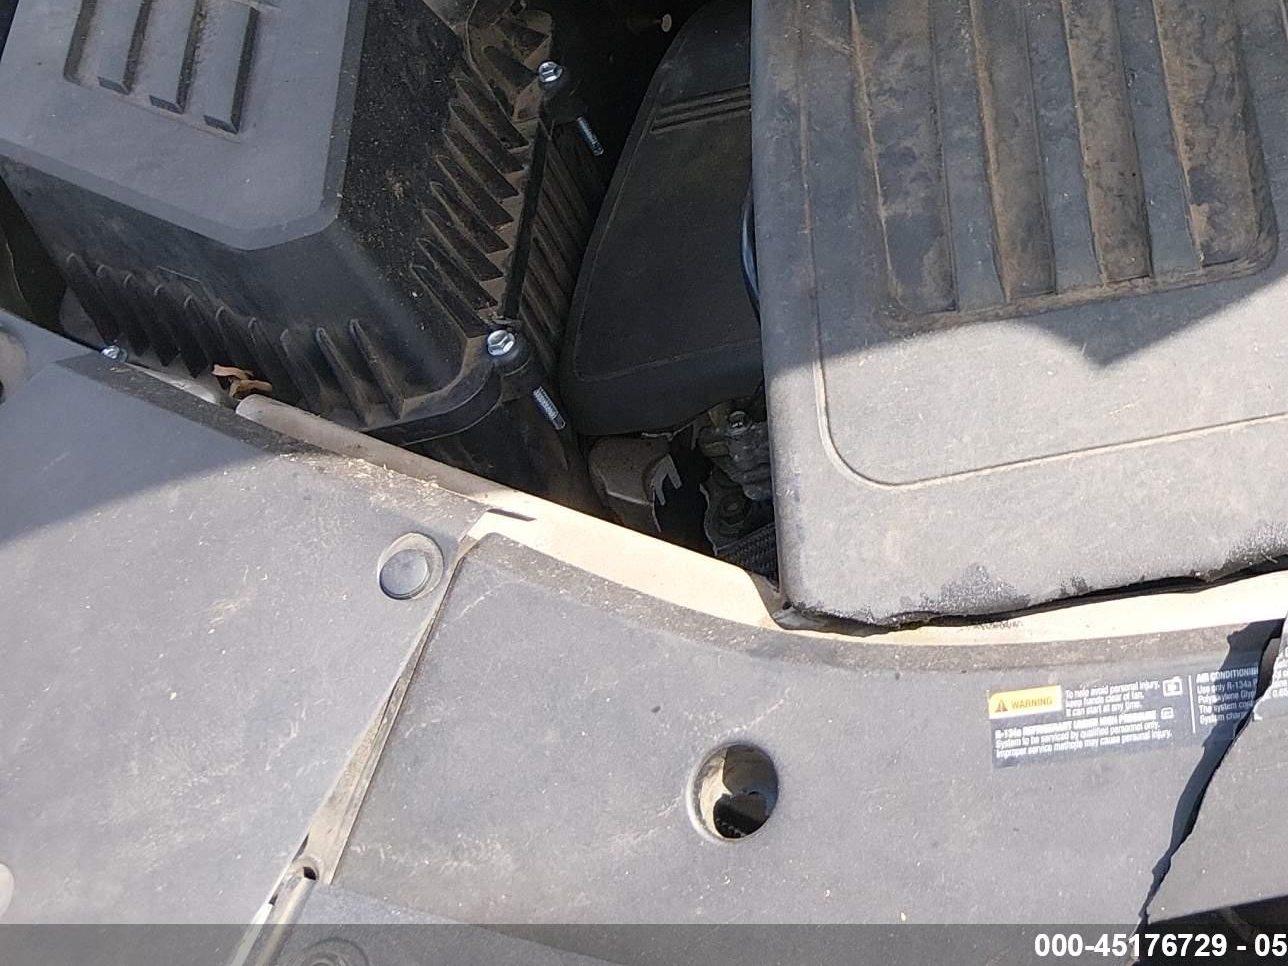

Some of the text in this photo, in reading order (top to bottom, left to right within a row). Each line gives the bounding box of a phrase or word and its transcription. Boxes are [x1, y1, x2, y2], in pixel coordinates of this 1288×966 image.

[1227, 681, 1252, 690] R-134a
[1011, 697, 1053, 709] WARNING
[995, 728, 1022, 739] R-134a
[995, 738, 1021, 750] System
